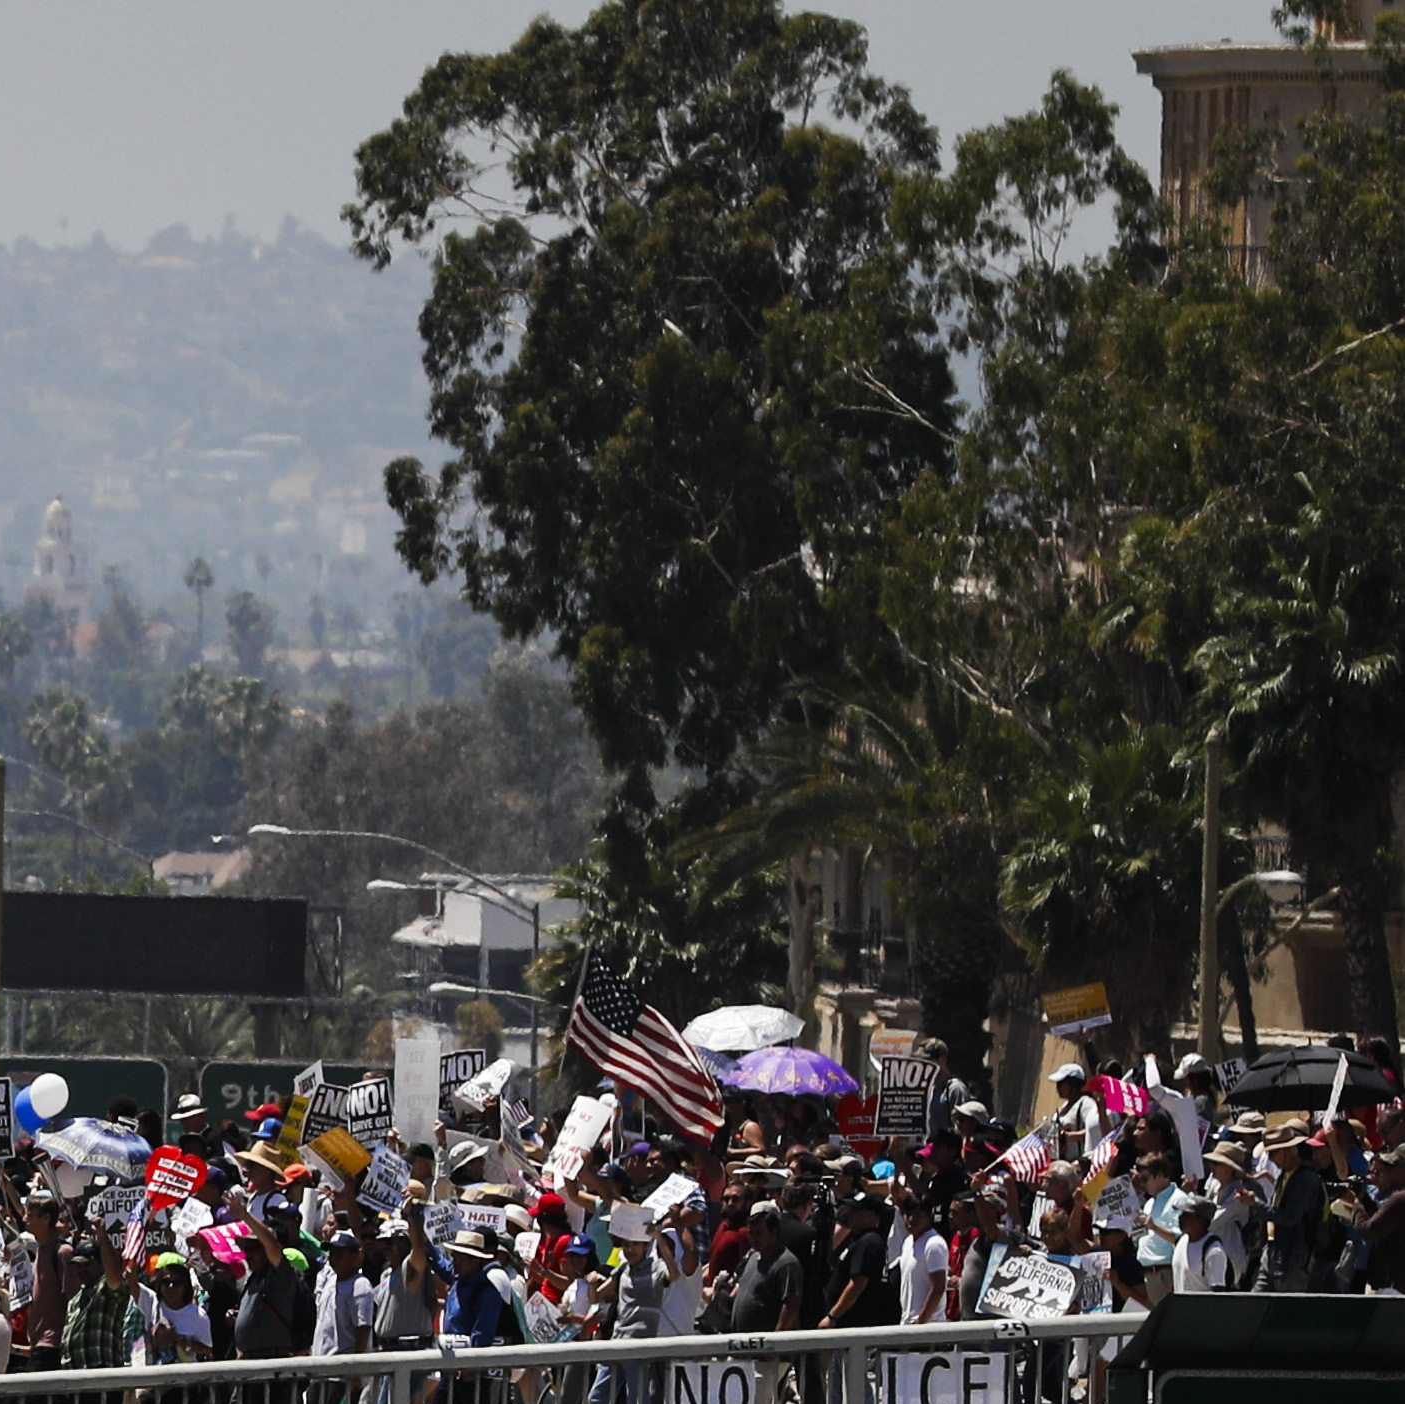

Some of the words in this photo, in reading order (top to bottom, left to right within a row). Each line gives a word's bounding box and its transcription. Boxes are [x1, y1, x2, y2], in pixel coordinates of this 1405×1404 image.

[882, 1060, 934, 1089] ¡NO!
[220, 1082, 280, 1109] 9th
[350, 1084, 388, 1117] NO!
[117, 1190, 137, 1199] OUT
[468, 1210, 501, 1225] HATE
[1006, 1260, 1073, 1293] CALIFORNIA
[1041, 1263, 1057, 1275] OUT
[1057, 1268, 1071, 1278] OF
